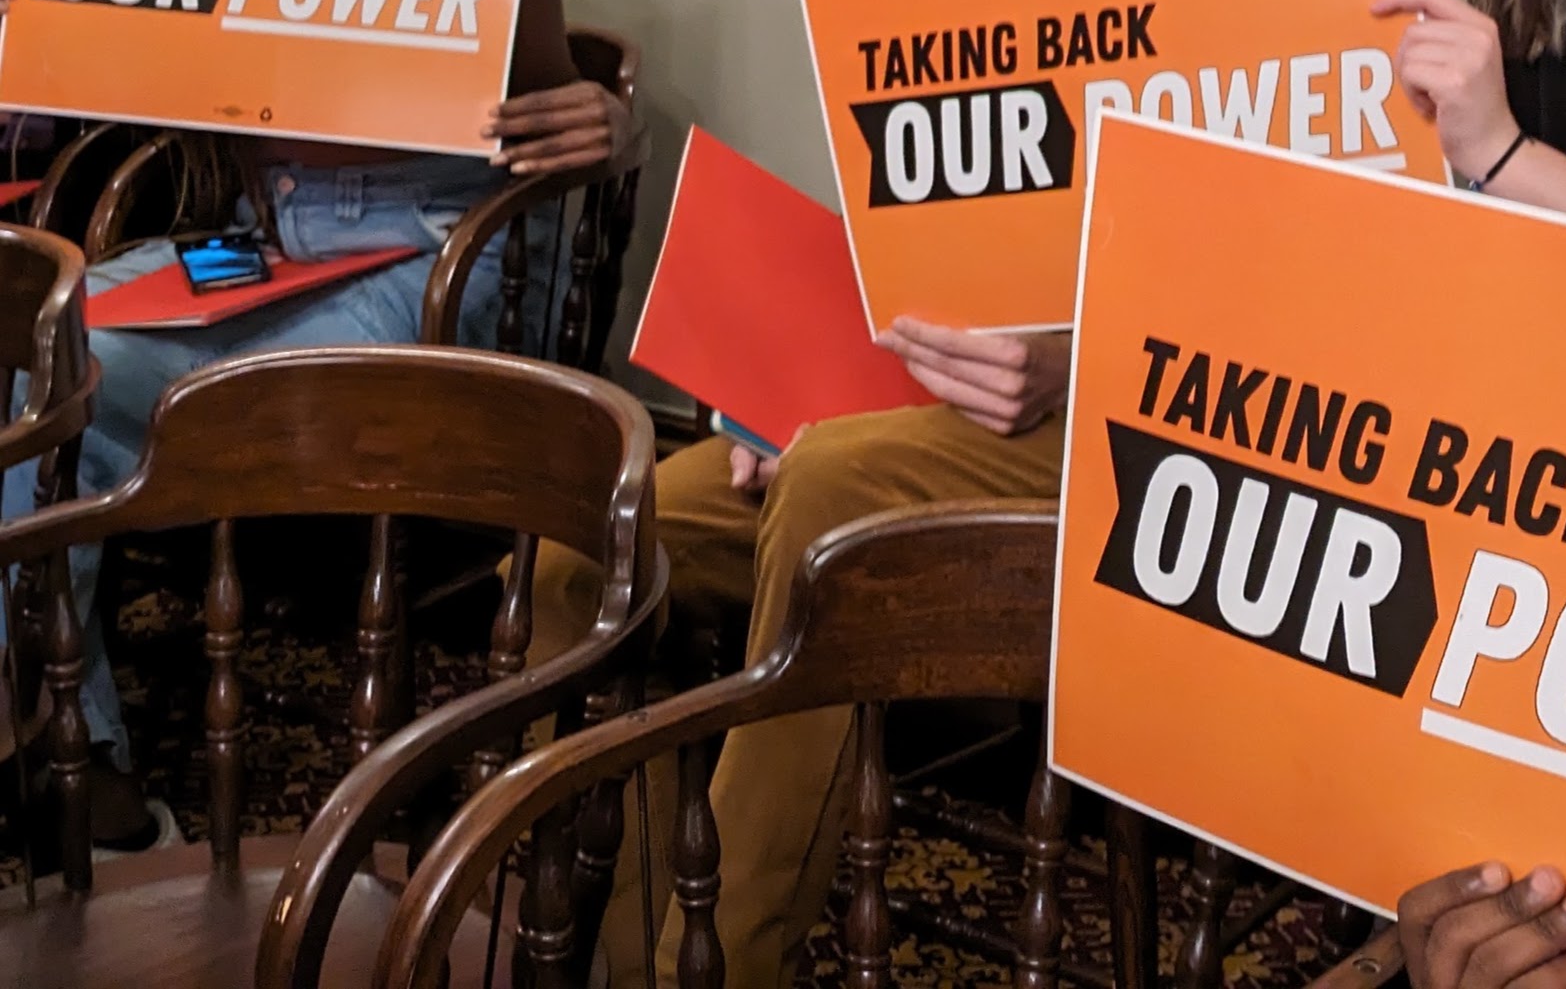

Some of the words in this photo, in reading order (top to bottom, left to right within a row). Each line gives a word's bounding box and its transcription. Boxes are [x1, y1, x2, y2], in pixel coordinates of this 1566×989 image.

[858, 22, 1018, 92] TAKING
[1036, 4, 1158, 71] BACK
[884, 89, 1055, 203] OUR
[1137, 336, 1393, 487] TAKING
[1132, 453, 1403, 680] OUR
